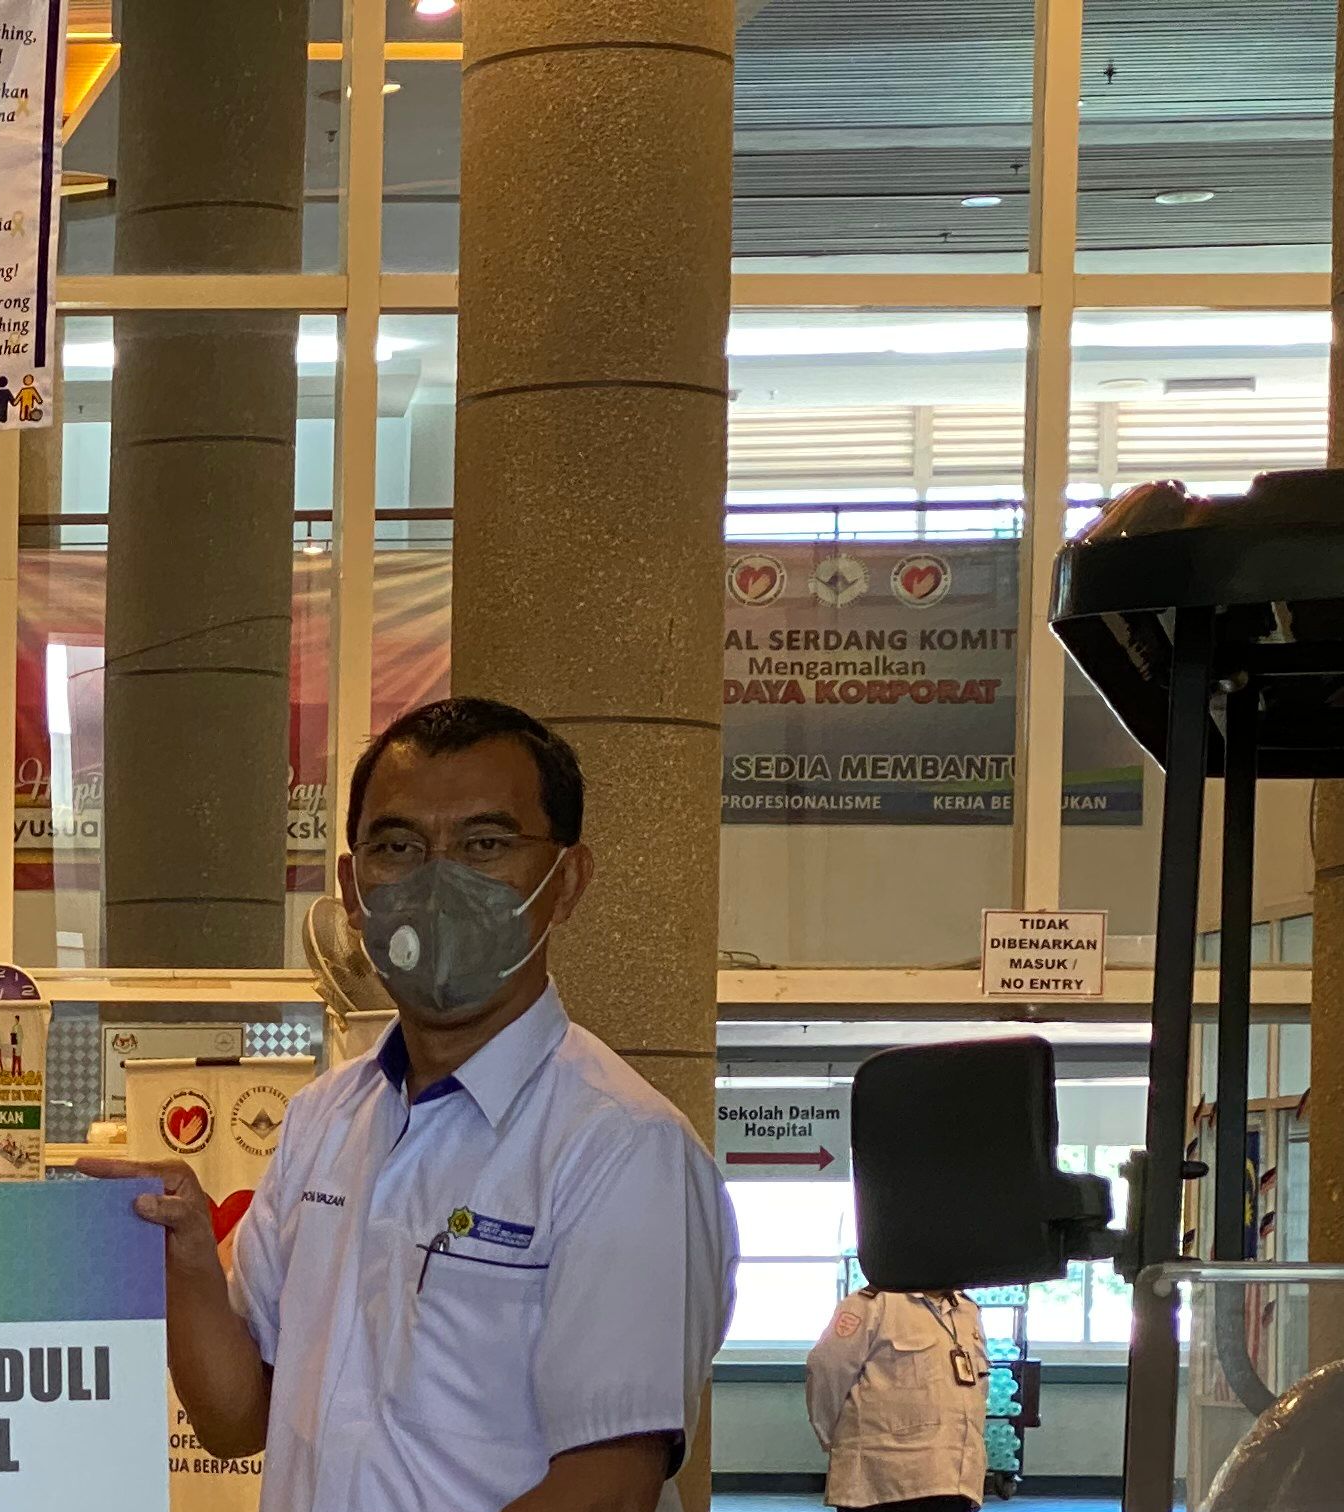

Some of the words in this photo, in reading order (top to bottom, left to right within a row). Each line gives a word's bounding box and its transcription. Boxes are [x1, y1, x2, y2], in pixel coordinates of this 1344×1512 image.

[769, 629, 908, 651] SERDANG
[920, 628, 1019, 651] KOMIT
[748, 656, 927, 681] Mengamalkan
[723, 679, 807, 705] DAYA
[815, 679, 1003, 705] KORPORAT
[732, 754, 831, 783] SEDIA
[933, 795, 986, 811] KERJA
[1019, 918, 1070, 930] TIDAK
[990, 937, 1098, 950] DIBENARKAN
[1009, 958, 1068, 970] MASUK
[1000, 978, 1024, 989] NO
[1029, 978, 1084, 990] ENTRY
[717, 1105, 783, 1121] Sekolah
[789, 1105, 840, 1120] Dalam
[744, 1122, 813, 1140] Hospital
[192, 1458, 263, 1475] BERPASU
